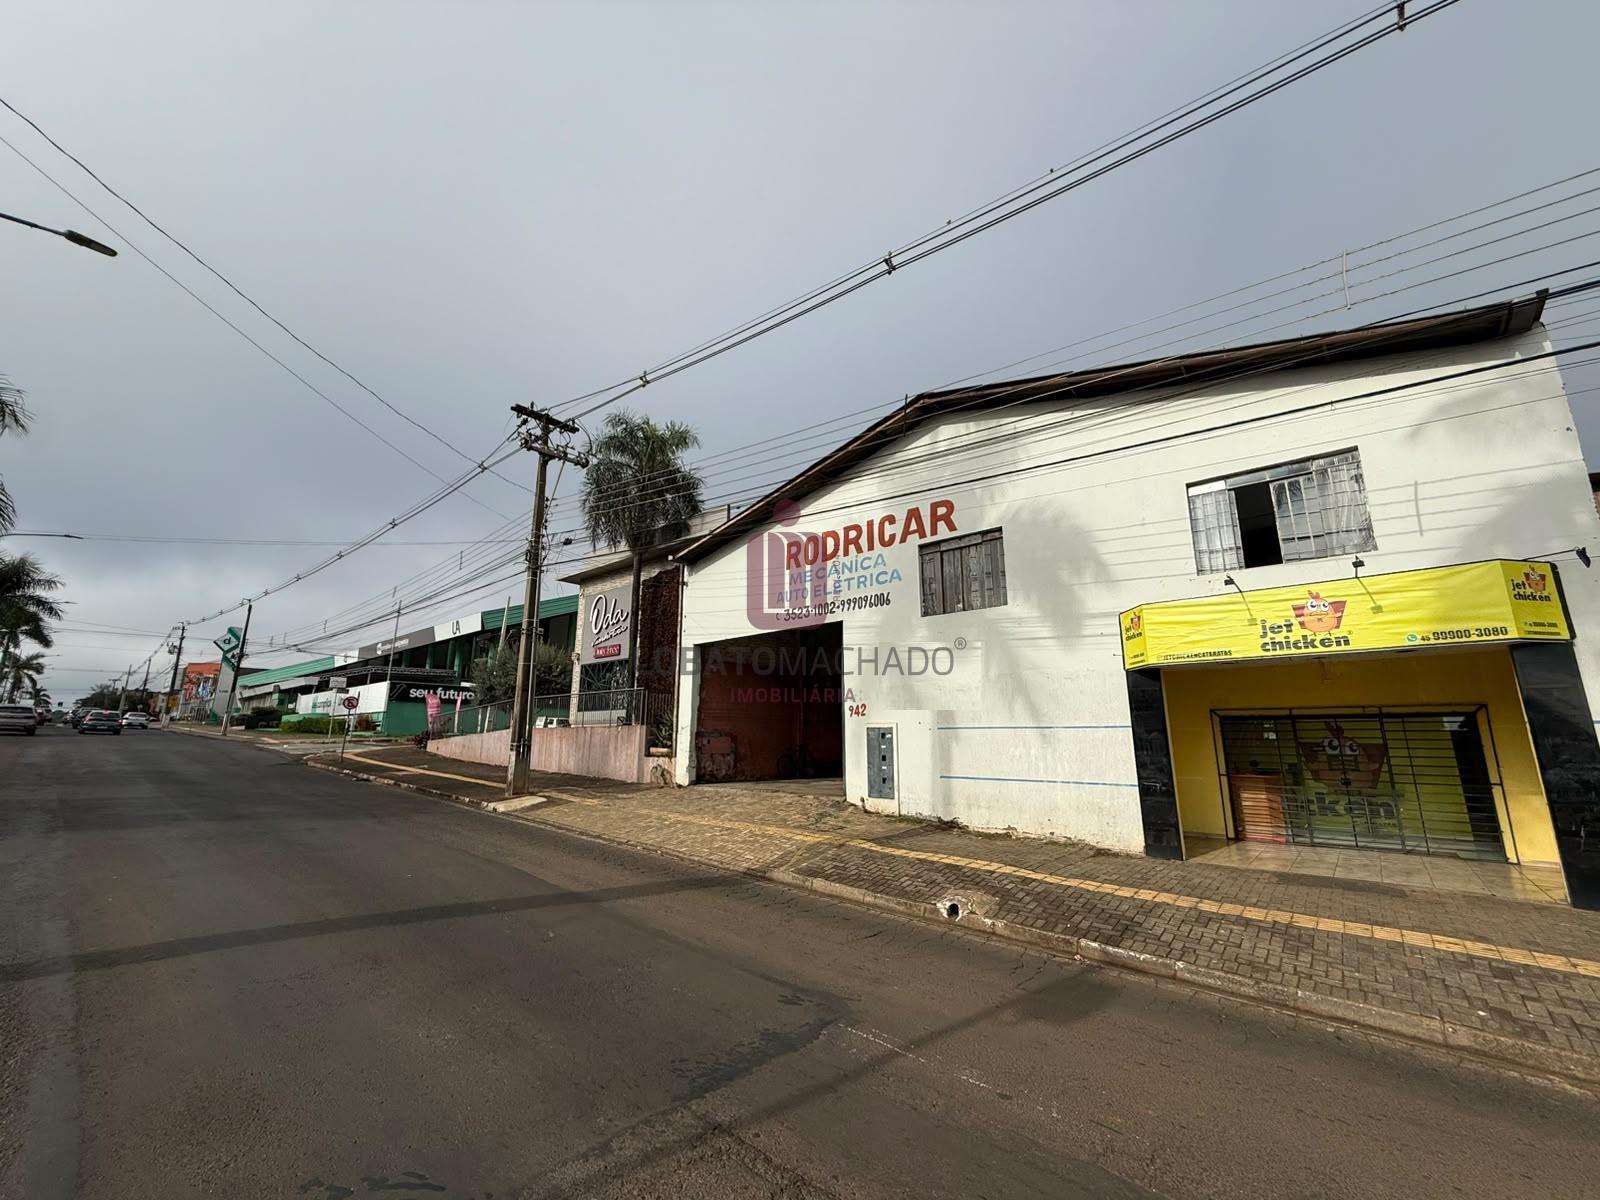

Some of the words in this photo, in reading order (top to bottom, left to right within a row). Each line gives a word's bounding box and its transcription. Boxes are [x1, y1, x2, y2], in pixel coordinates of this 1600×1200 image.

[785, 498, 958, 571] RODRICAR
[1511, 578, 1527, 591] jet
[776, 587, 809, 605] AUTO
[1513, 591, 1551, 602] chicken
[590, 594, 629, 635] Oda
[1260, 619, 1294, 639] jet
[1420, 634, 1431, 642] 45
[1432, 626, 1509, 641] 99900-3080
[1260, 635, 1351, 652] chicken
[848, 703, 867, 718] 942
